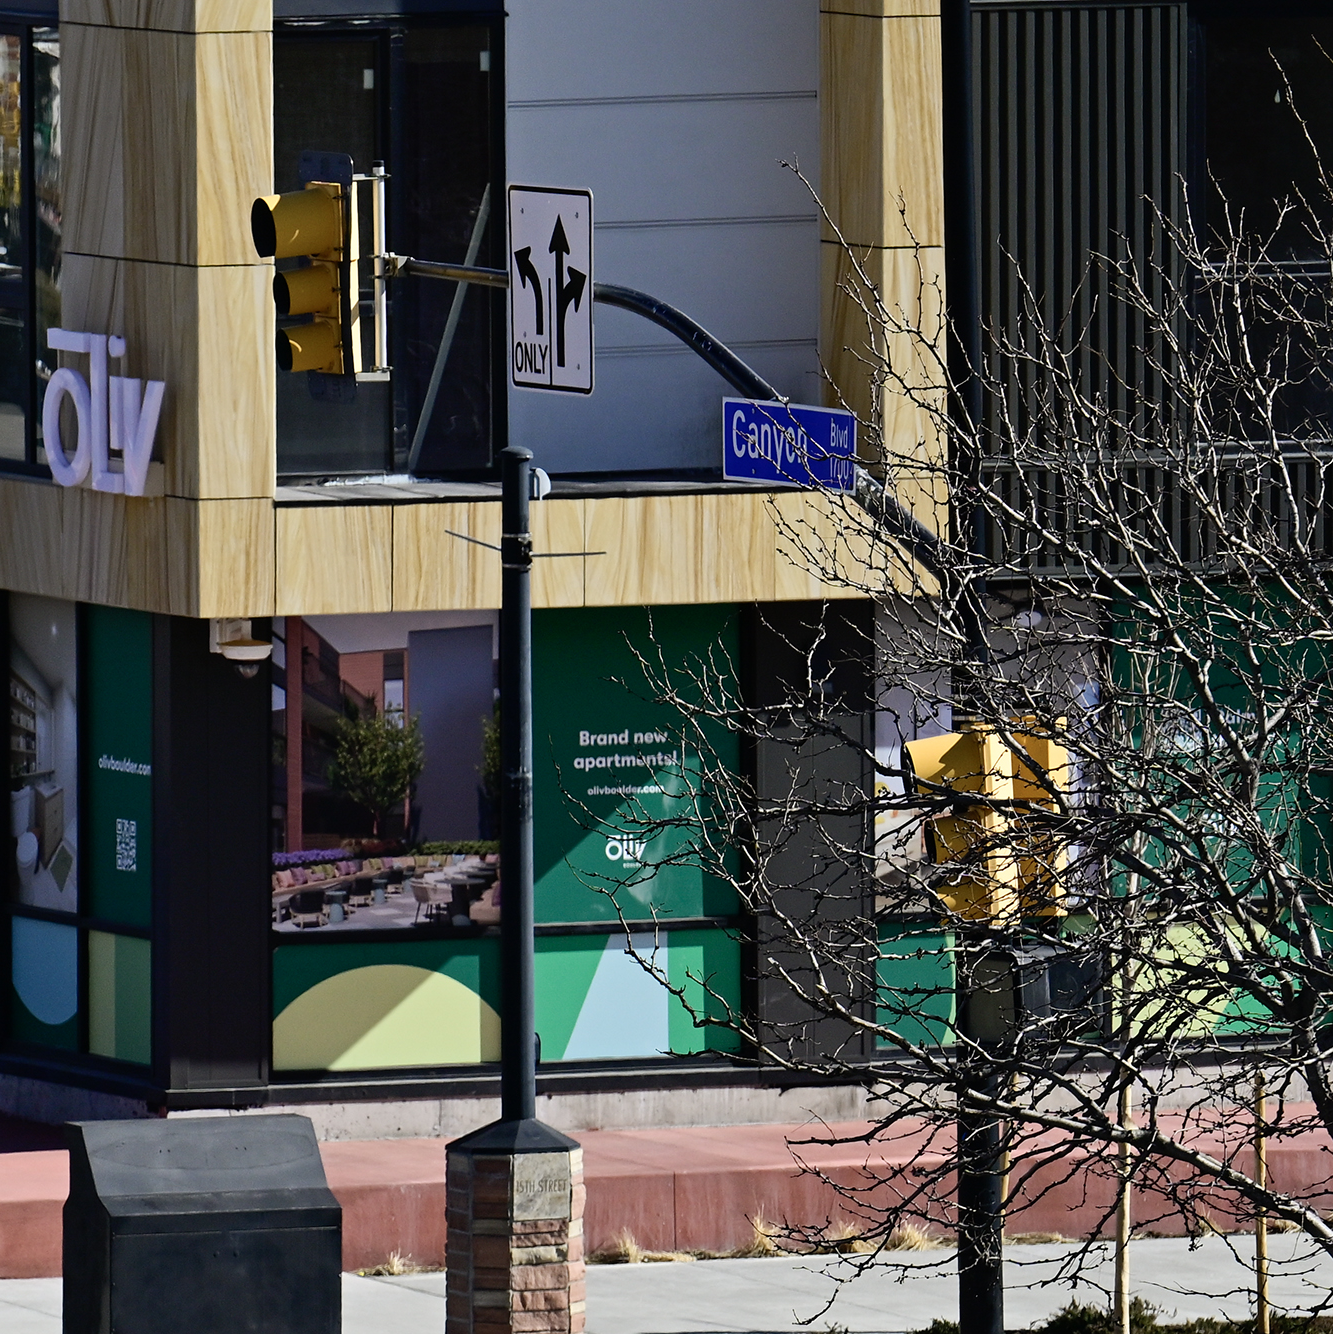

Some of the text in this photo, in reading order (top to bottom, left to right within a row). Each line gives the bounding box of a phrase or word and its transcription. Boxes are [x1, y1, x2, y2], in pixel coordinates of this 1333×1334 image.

[515, 341, 548, 374] ONLY
[733, 409, 849, 474] Canyon Blvd
[579, 729, 668, 746] Brand new
[573, 750, 677, 772] apartments!
[587, 784, 664, 796] olivboulder.com
[516, 1179, 567, 1194] 15TH STREET
